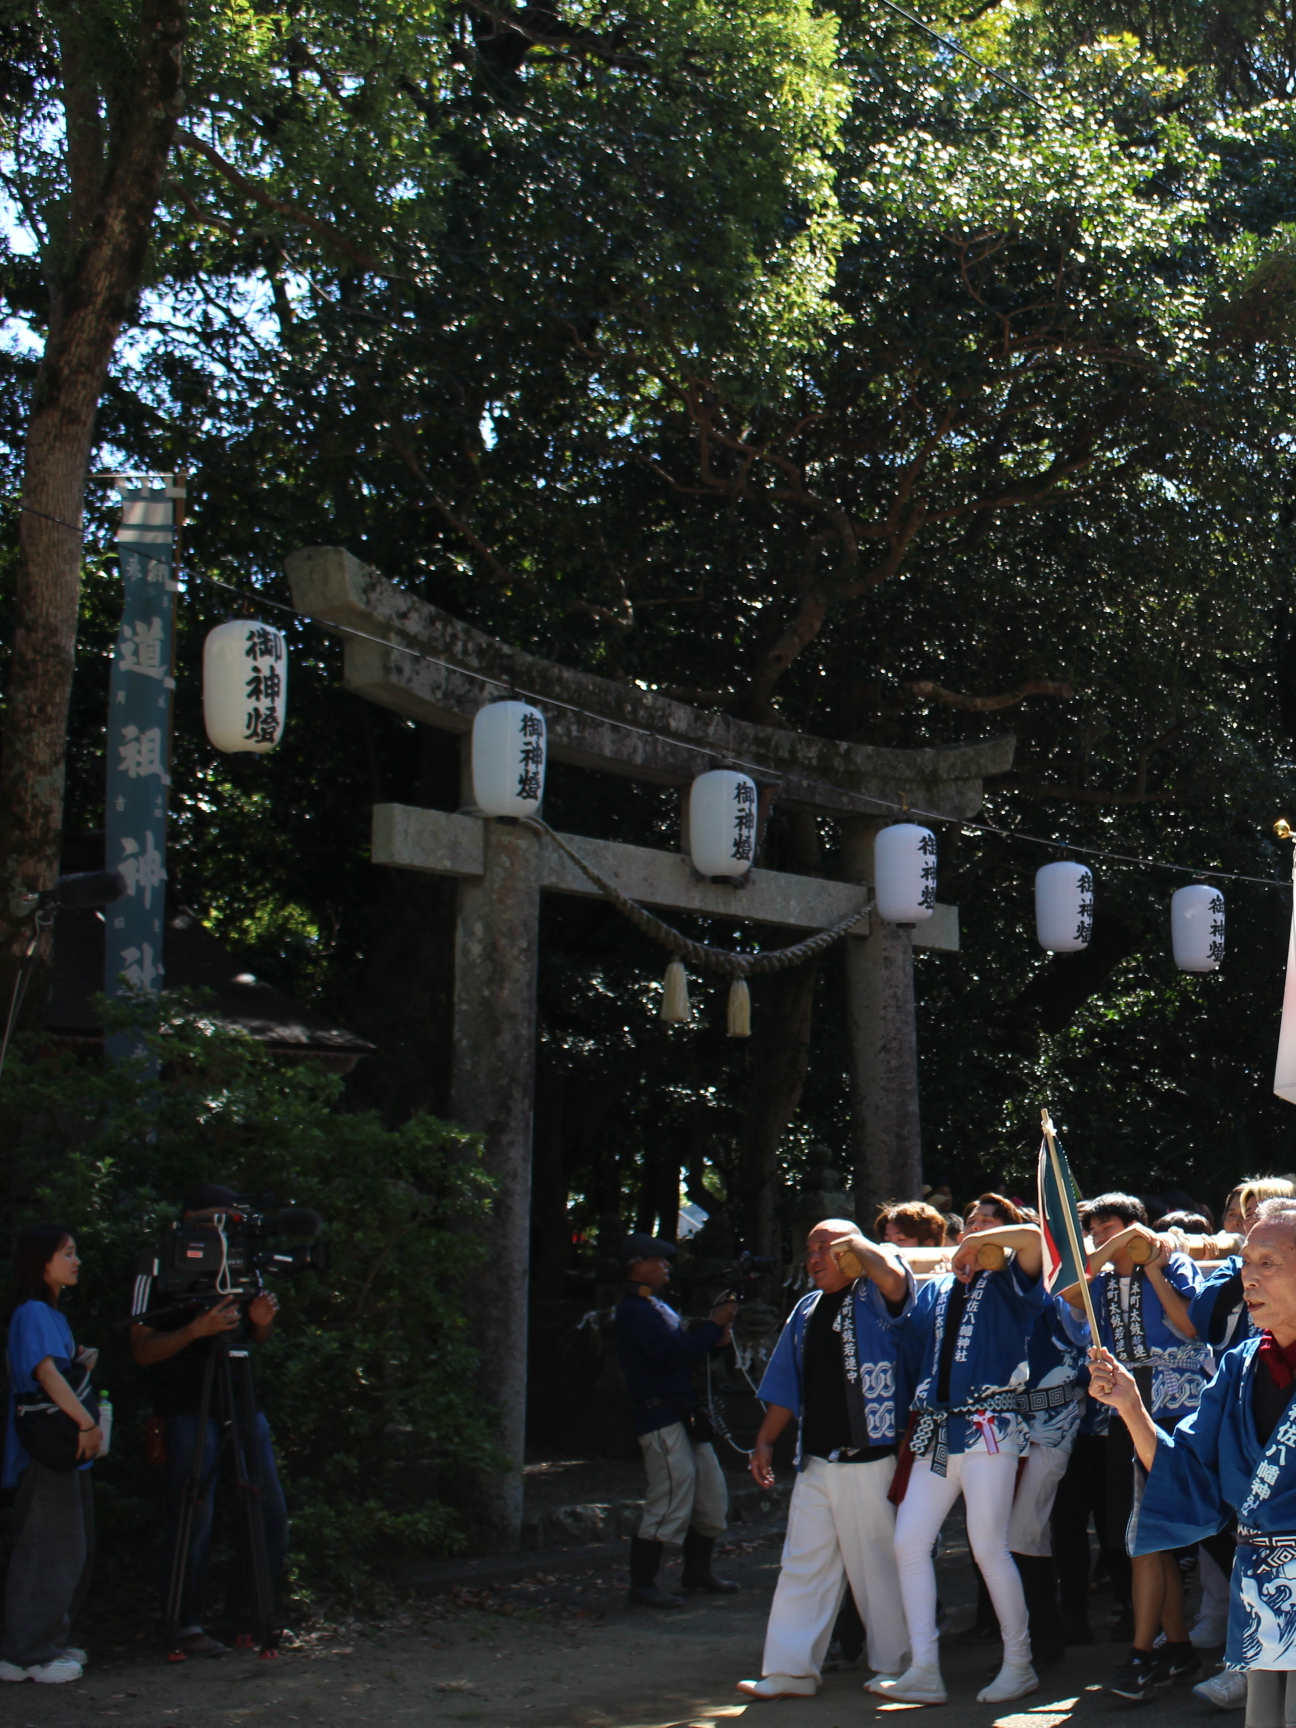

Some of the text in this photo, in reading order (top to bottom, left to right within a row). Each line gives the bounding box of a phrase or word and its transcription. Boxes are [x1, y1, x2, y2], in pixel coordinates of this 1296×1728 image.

[244, 627, 282, 744] 御神燈
[115, 616, 168, 998] 道祖神社
[516, 713, 543, 801] 御神燈
[731, 781, 754, 862] 御神燈
